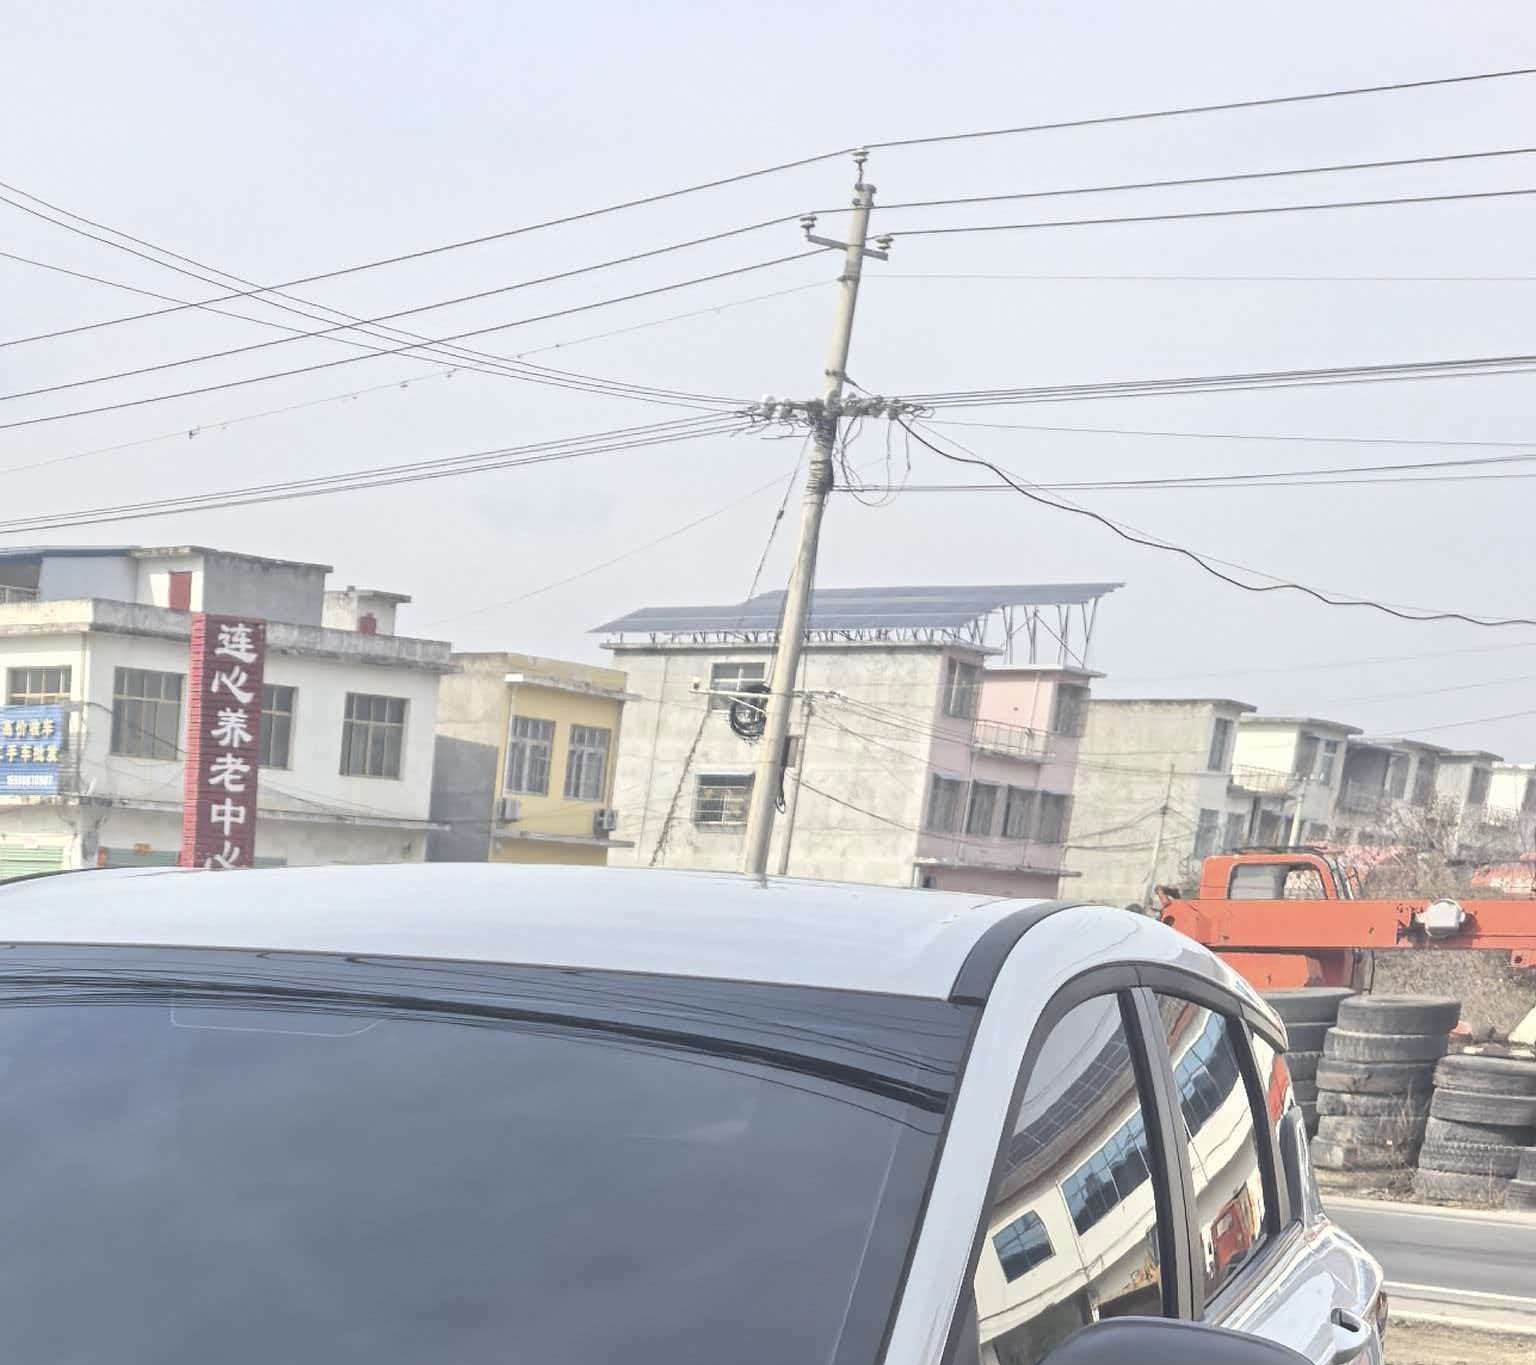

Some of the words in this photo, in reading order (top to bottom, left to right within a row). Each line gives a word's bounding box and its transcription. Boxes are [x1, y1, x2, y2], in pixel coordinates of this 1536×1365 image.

[205, 622, 258, 869] 连心养老中心
